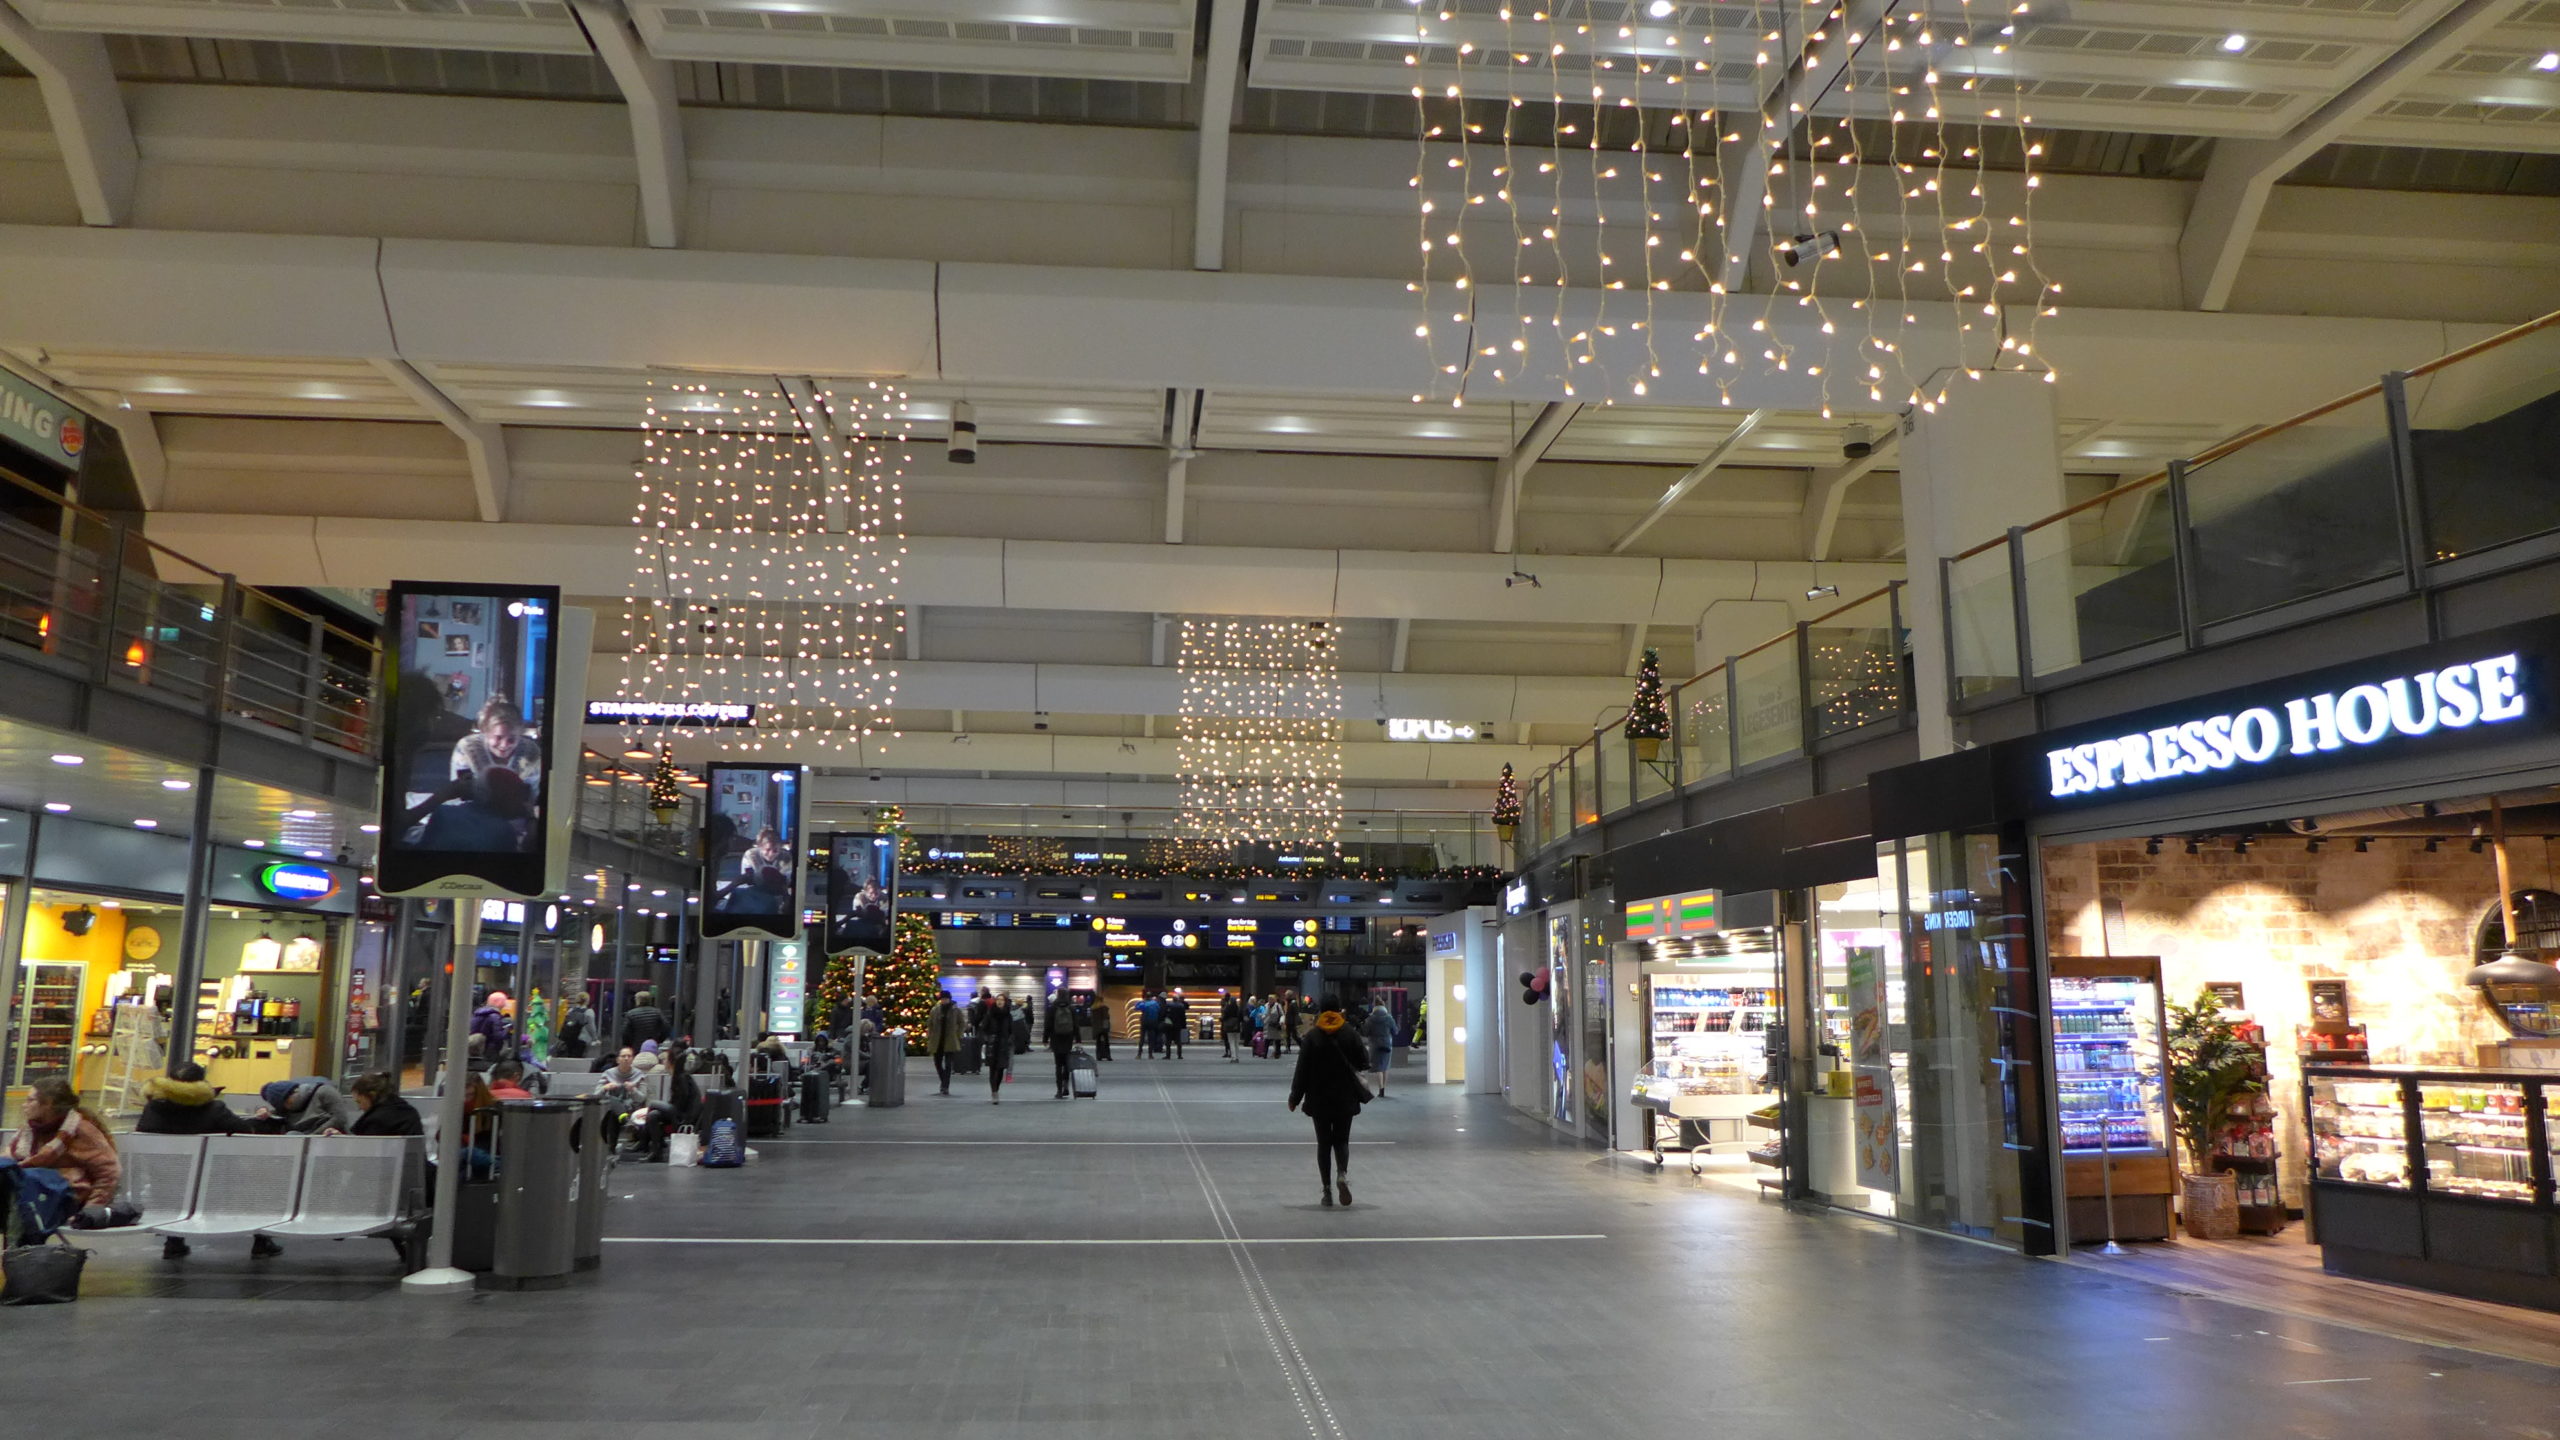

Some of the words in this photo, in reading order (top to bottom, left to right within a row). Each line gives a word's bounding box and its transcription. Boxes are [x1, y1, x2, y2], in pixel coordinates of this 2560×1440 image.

[0, 385, 53, 439] ING
[589, 702, 686, 717] STARBUCKS
[2048, 708, 2280, 797] ESPRESSO
[2284, 653, 2526, 755] HOUSE
[1311, 960, 1320, 968] 10
